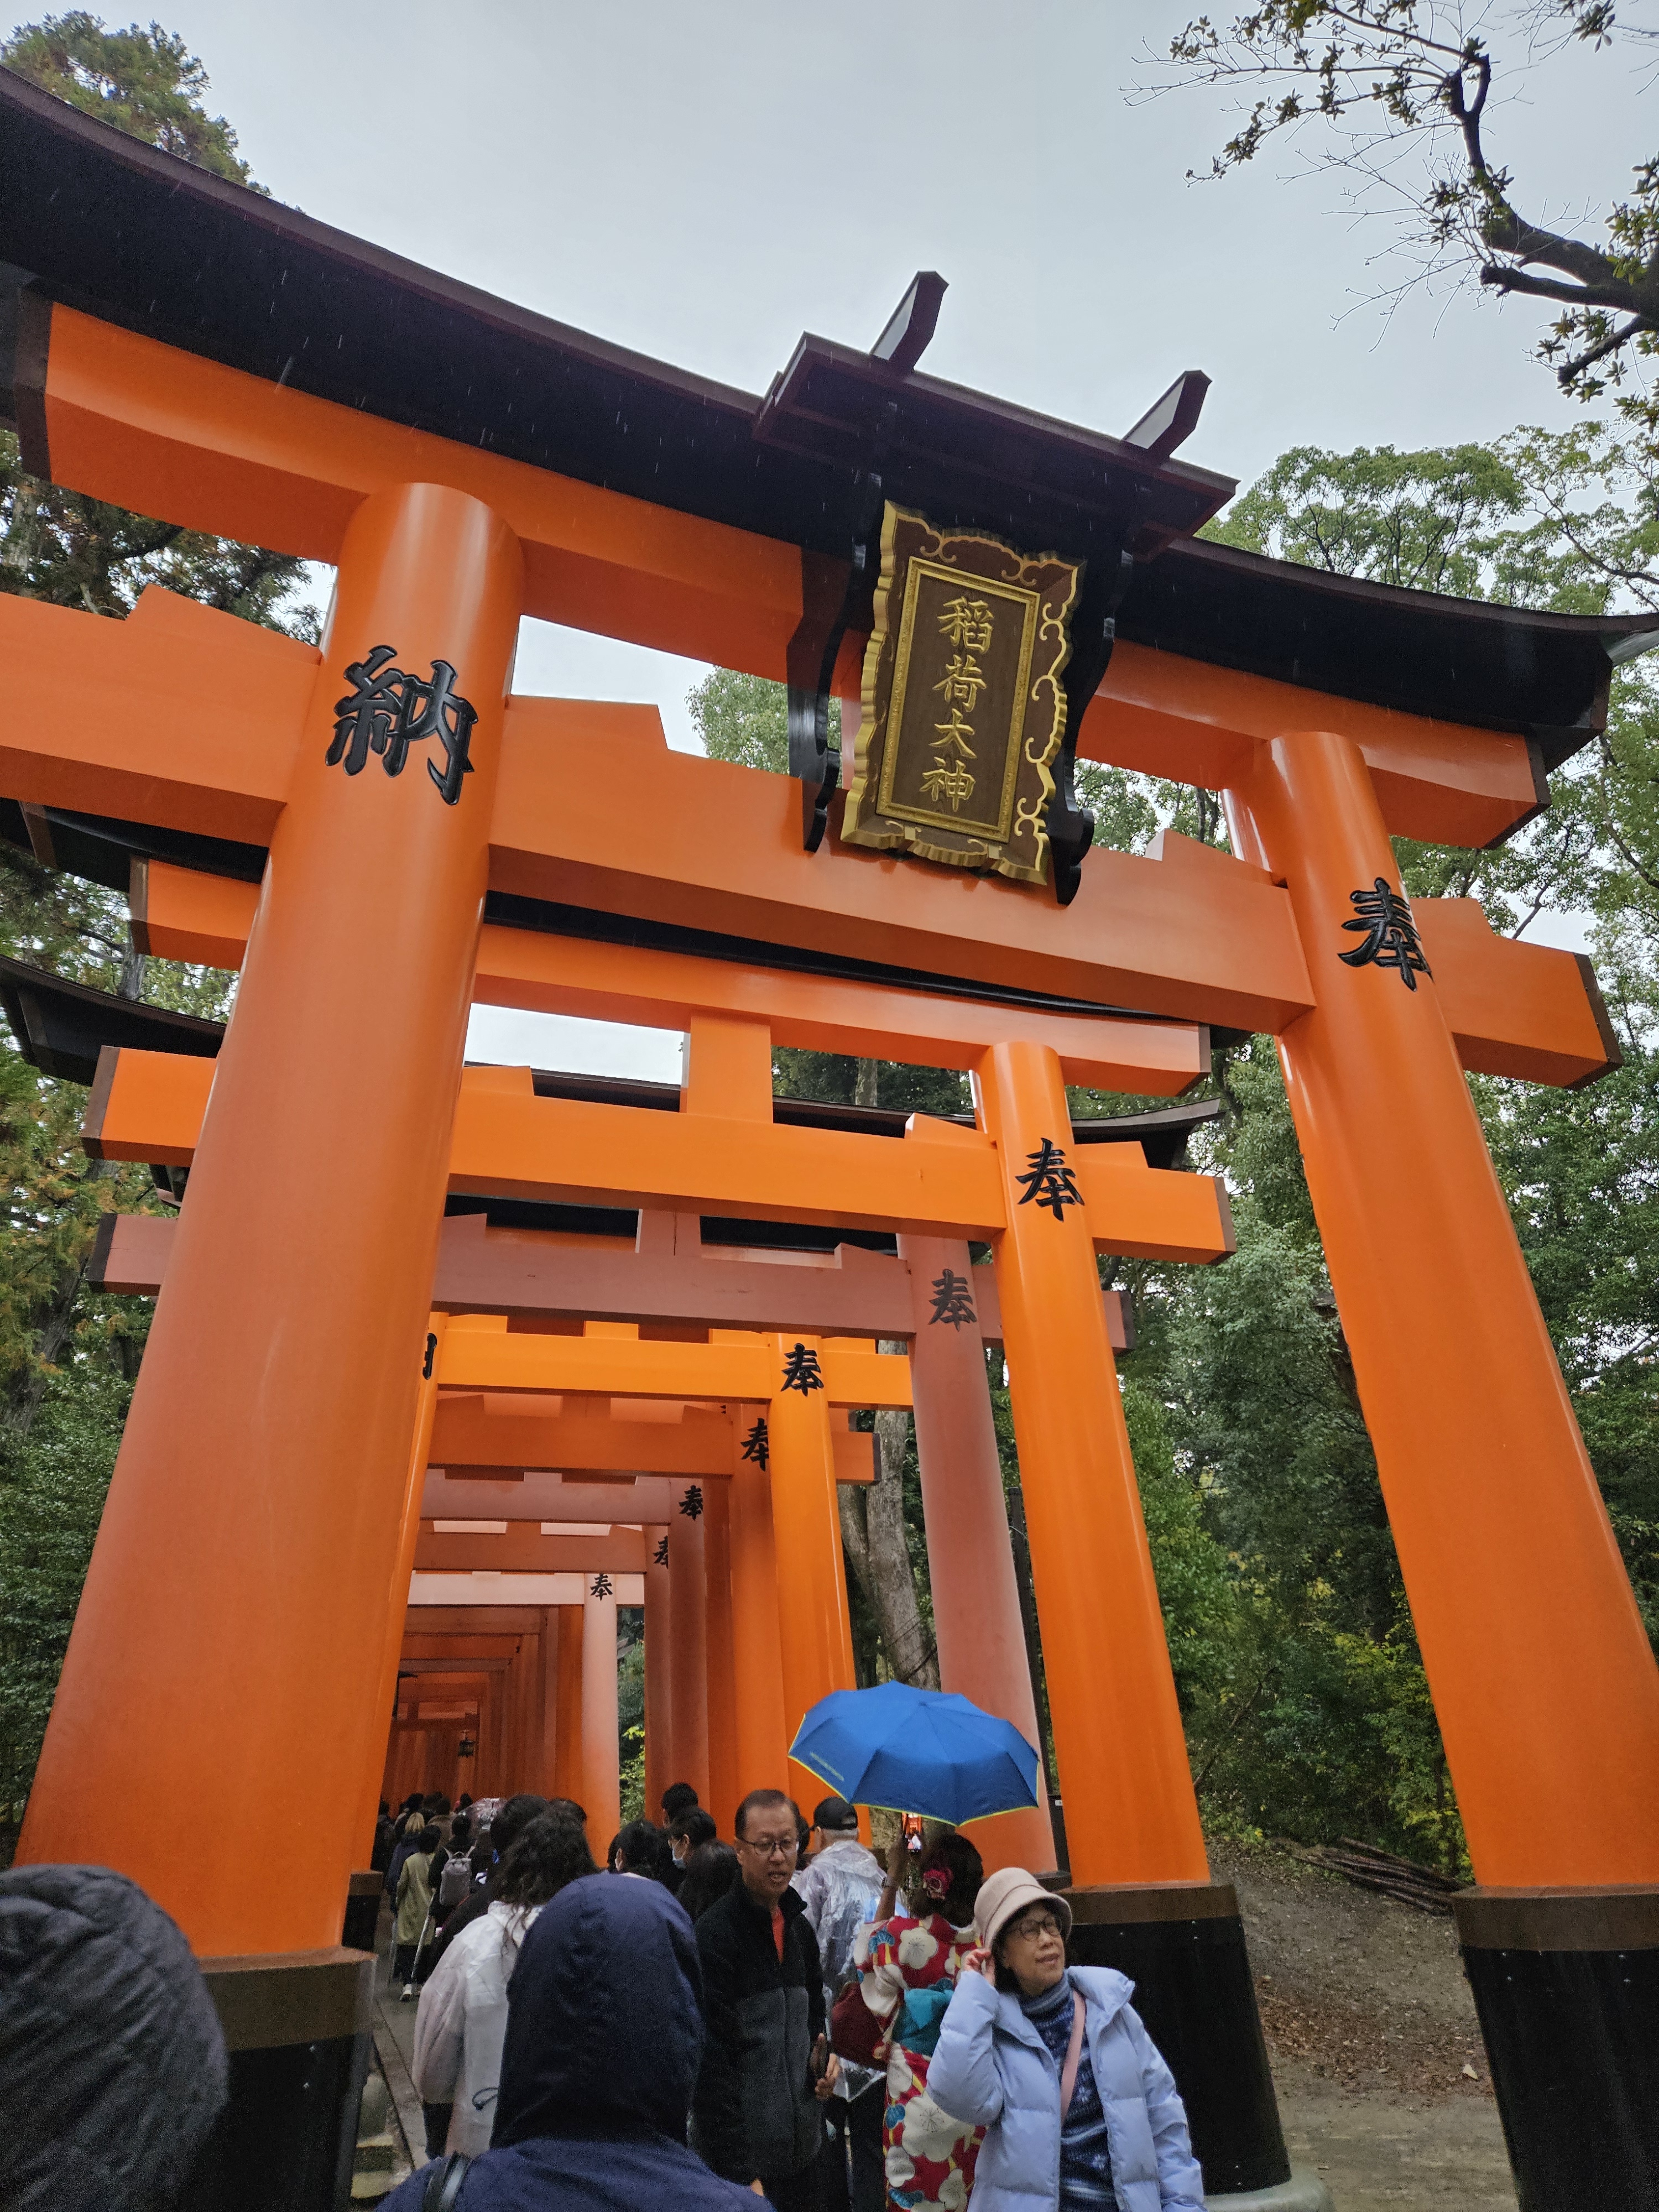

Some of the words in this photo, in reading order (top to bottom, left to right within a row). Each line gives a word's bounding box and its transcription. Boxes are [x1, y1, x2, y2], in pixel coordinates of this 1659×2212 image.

[1337, 877, 1435, 992] 奉
[1015, 1137, 1085, 1222] 奉
[928, 1269, 977, 1332] 奉
[780, 1343, 824, 1397] 奉
[740, 1418, 769, 1472] 奉
[679, 1485, 703, 1521] 奉
[589, 1573, 613, 1601] 奉
